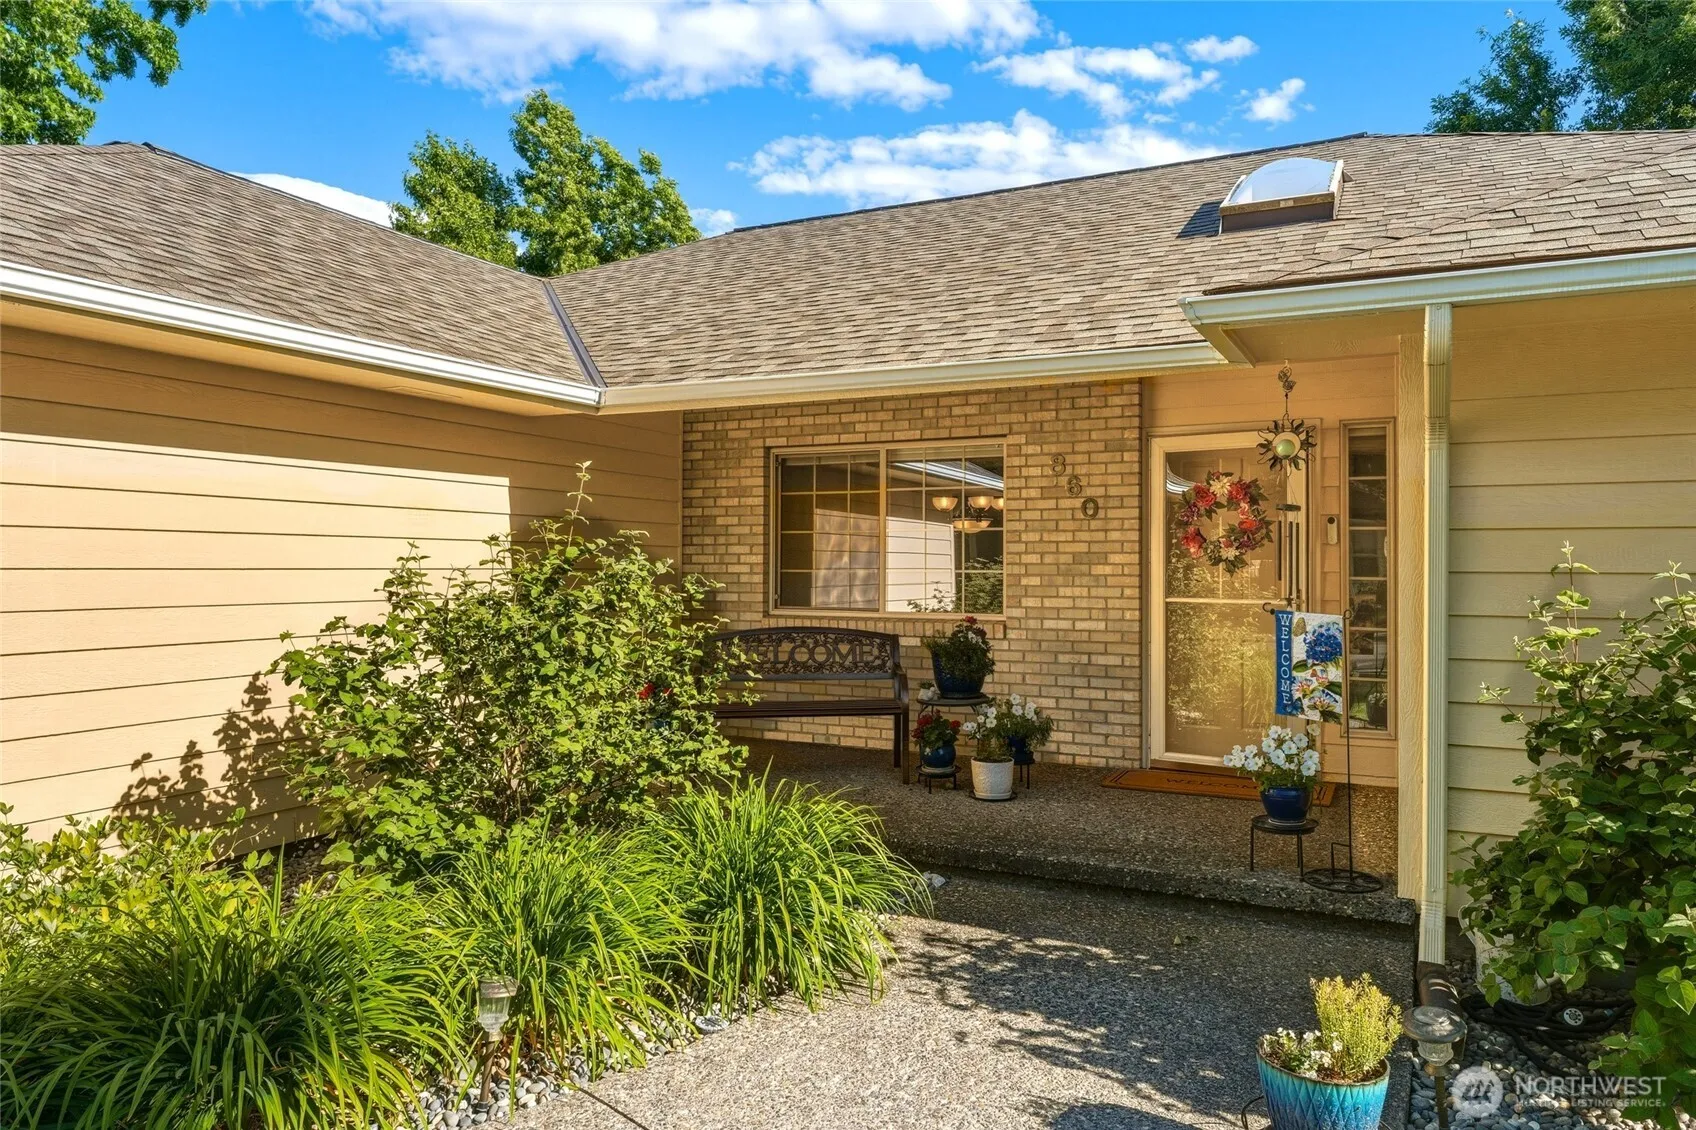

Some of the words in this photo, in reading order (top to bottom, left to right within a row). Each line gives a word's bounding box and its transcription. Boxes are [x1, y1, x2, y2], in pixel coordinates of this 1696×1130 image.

[1049, 453, 1099, 519] 860
[1278, 613, 1292, 704] WELCOME
[1166, 778, 1259, 791] WELCOM
